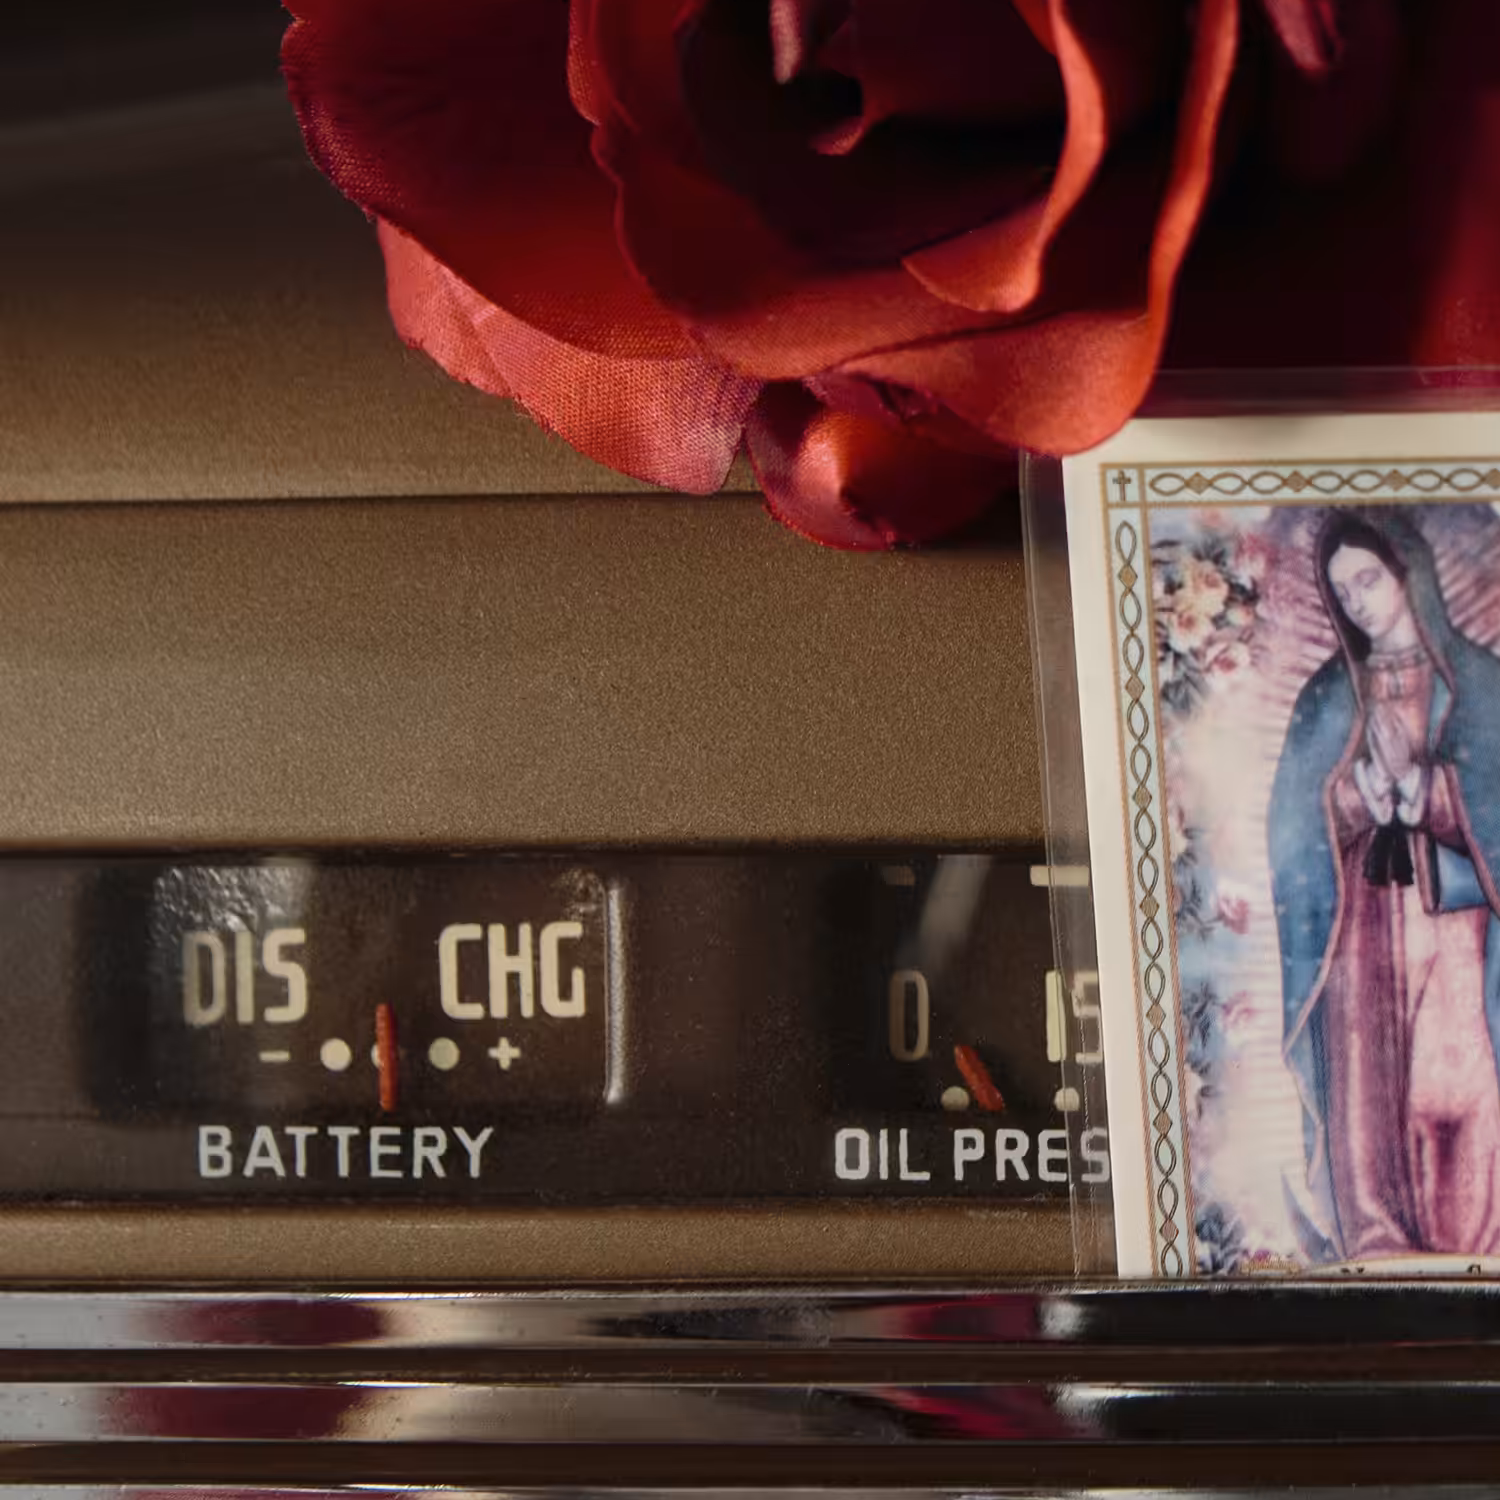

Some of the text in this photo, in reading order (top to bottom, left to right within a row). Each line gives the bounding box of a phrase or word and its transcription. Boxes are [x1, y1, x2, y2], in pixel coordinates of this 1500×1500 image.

[182, 922, 586, 1026] DIS CHG
[200, 1126, 494, 1179] BATTERY
[835, 1127, 1109, 1182] OIL PRES
